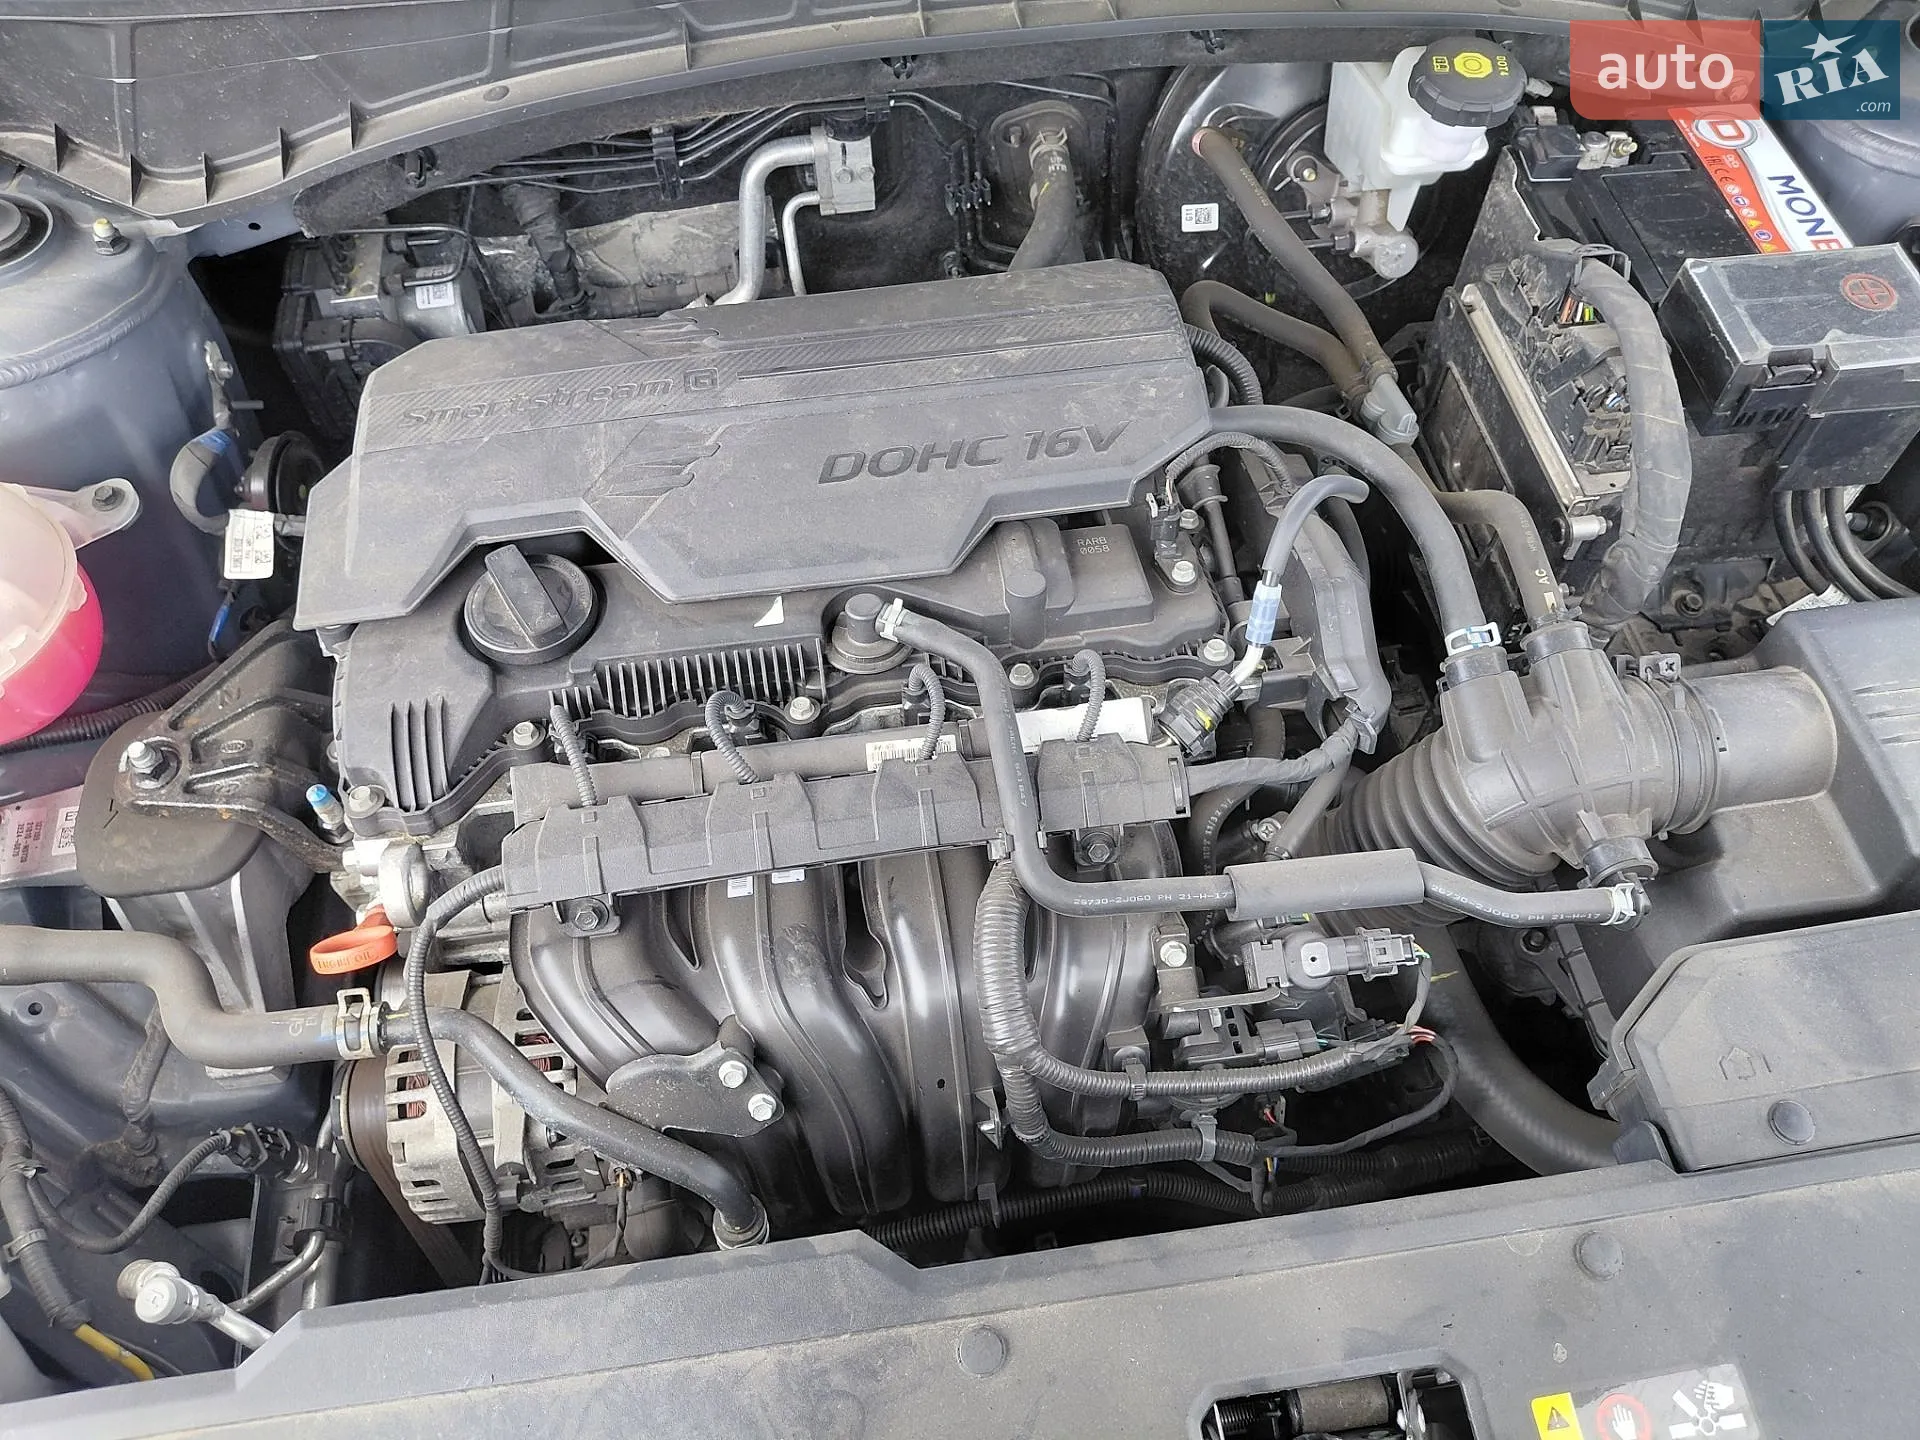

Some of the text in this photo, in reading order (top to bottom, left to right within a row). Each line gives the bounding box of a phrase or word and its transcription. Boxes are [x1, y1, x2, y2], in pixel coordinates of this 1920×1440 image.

[402, 376, 674, 425] Smartstream
[817, 419, 1132, 485] DOHC 16V
[1077, 536, 1107, 547] RARB
[1535, 568, 1550, 585] AC
